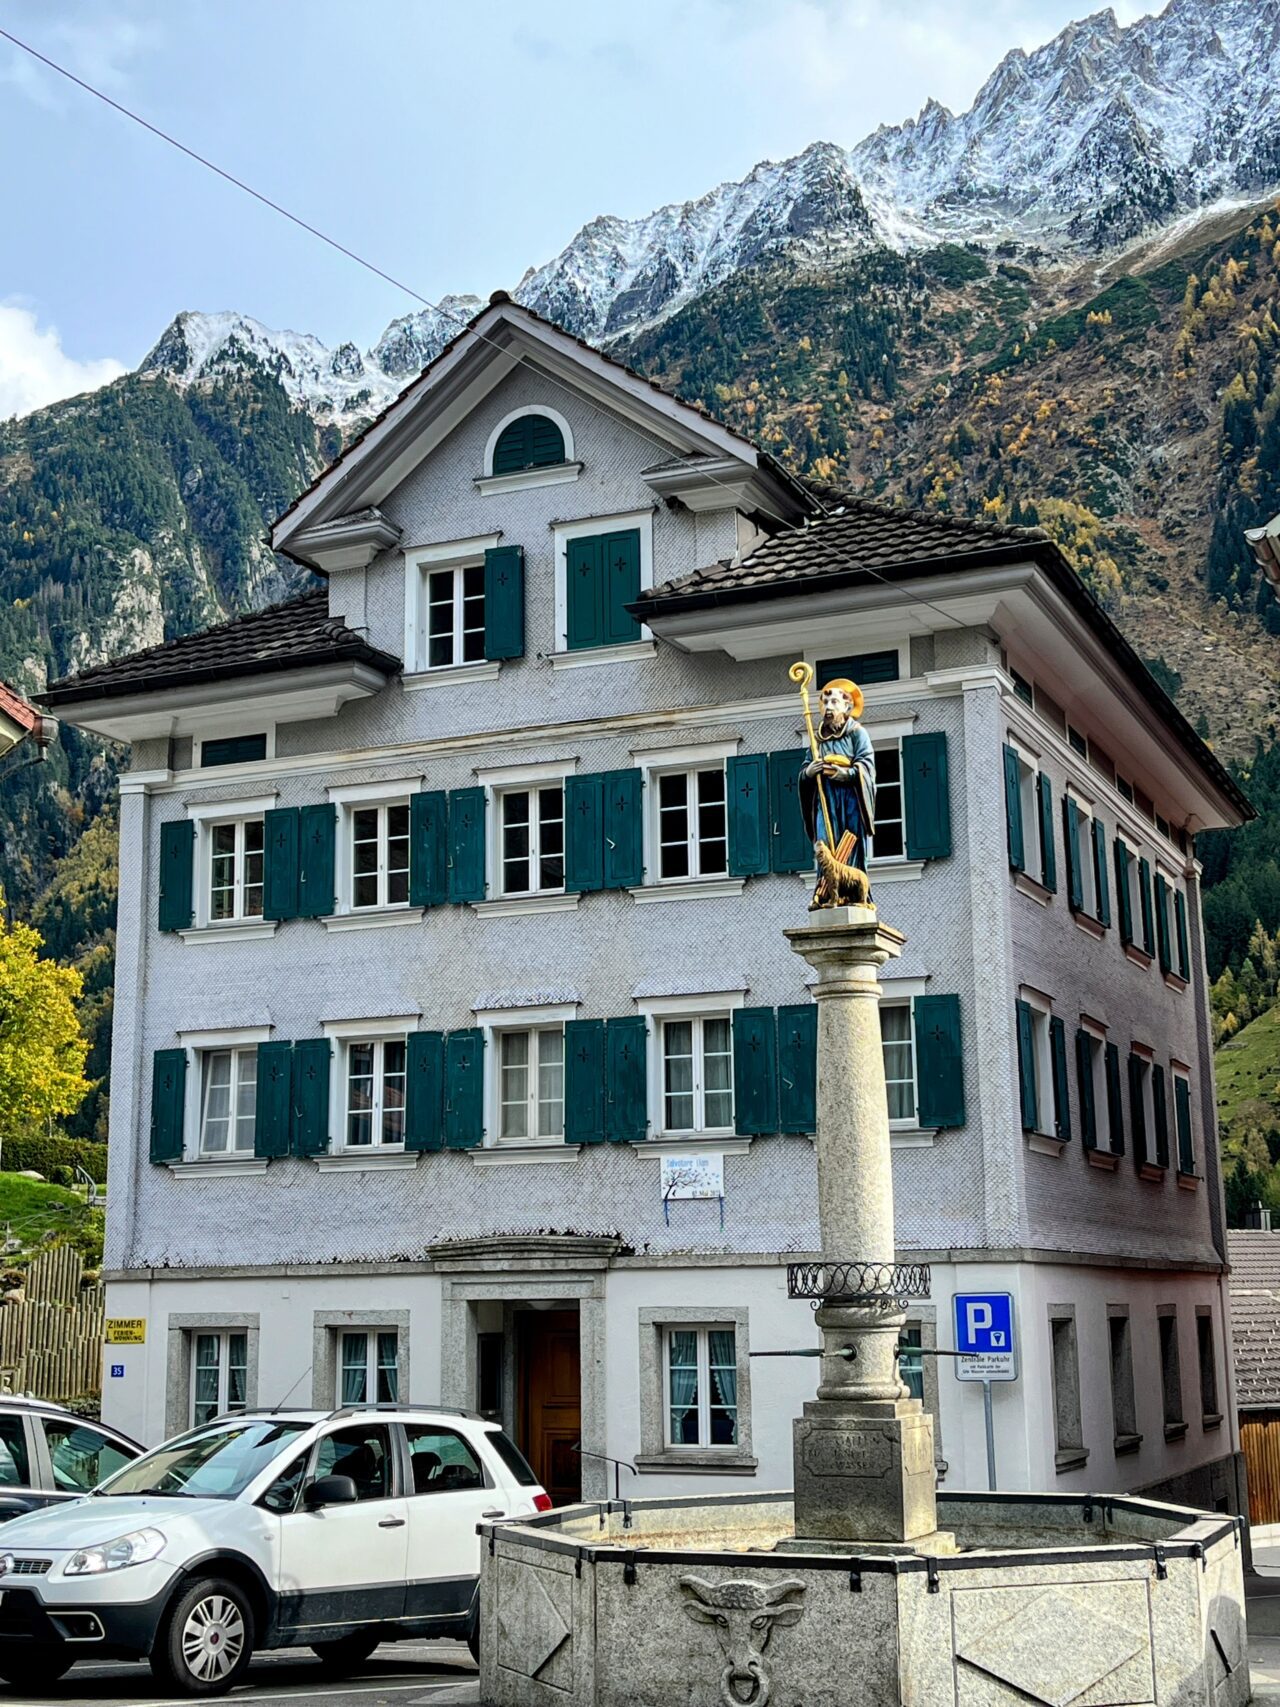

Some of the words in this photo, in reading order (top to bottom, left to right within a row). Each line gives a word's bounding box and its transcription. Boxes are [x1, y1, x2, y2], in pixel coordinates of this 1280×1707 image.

[108, 1320, 142, 1329] ZIMMER
[966, 1302, 993, 1344] P
[961, 1355, 985, 1363] Zentrale
[987, 1355, 1010, 1363] Parkuhr
[113, 1366, 122, 1376] 35
